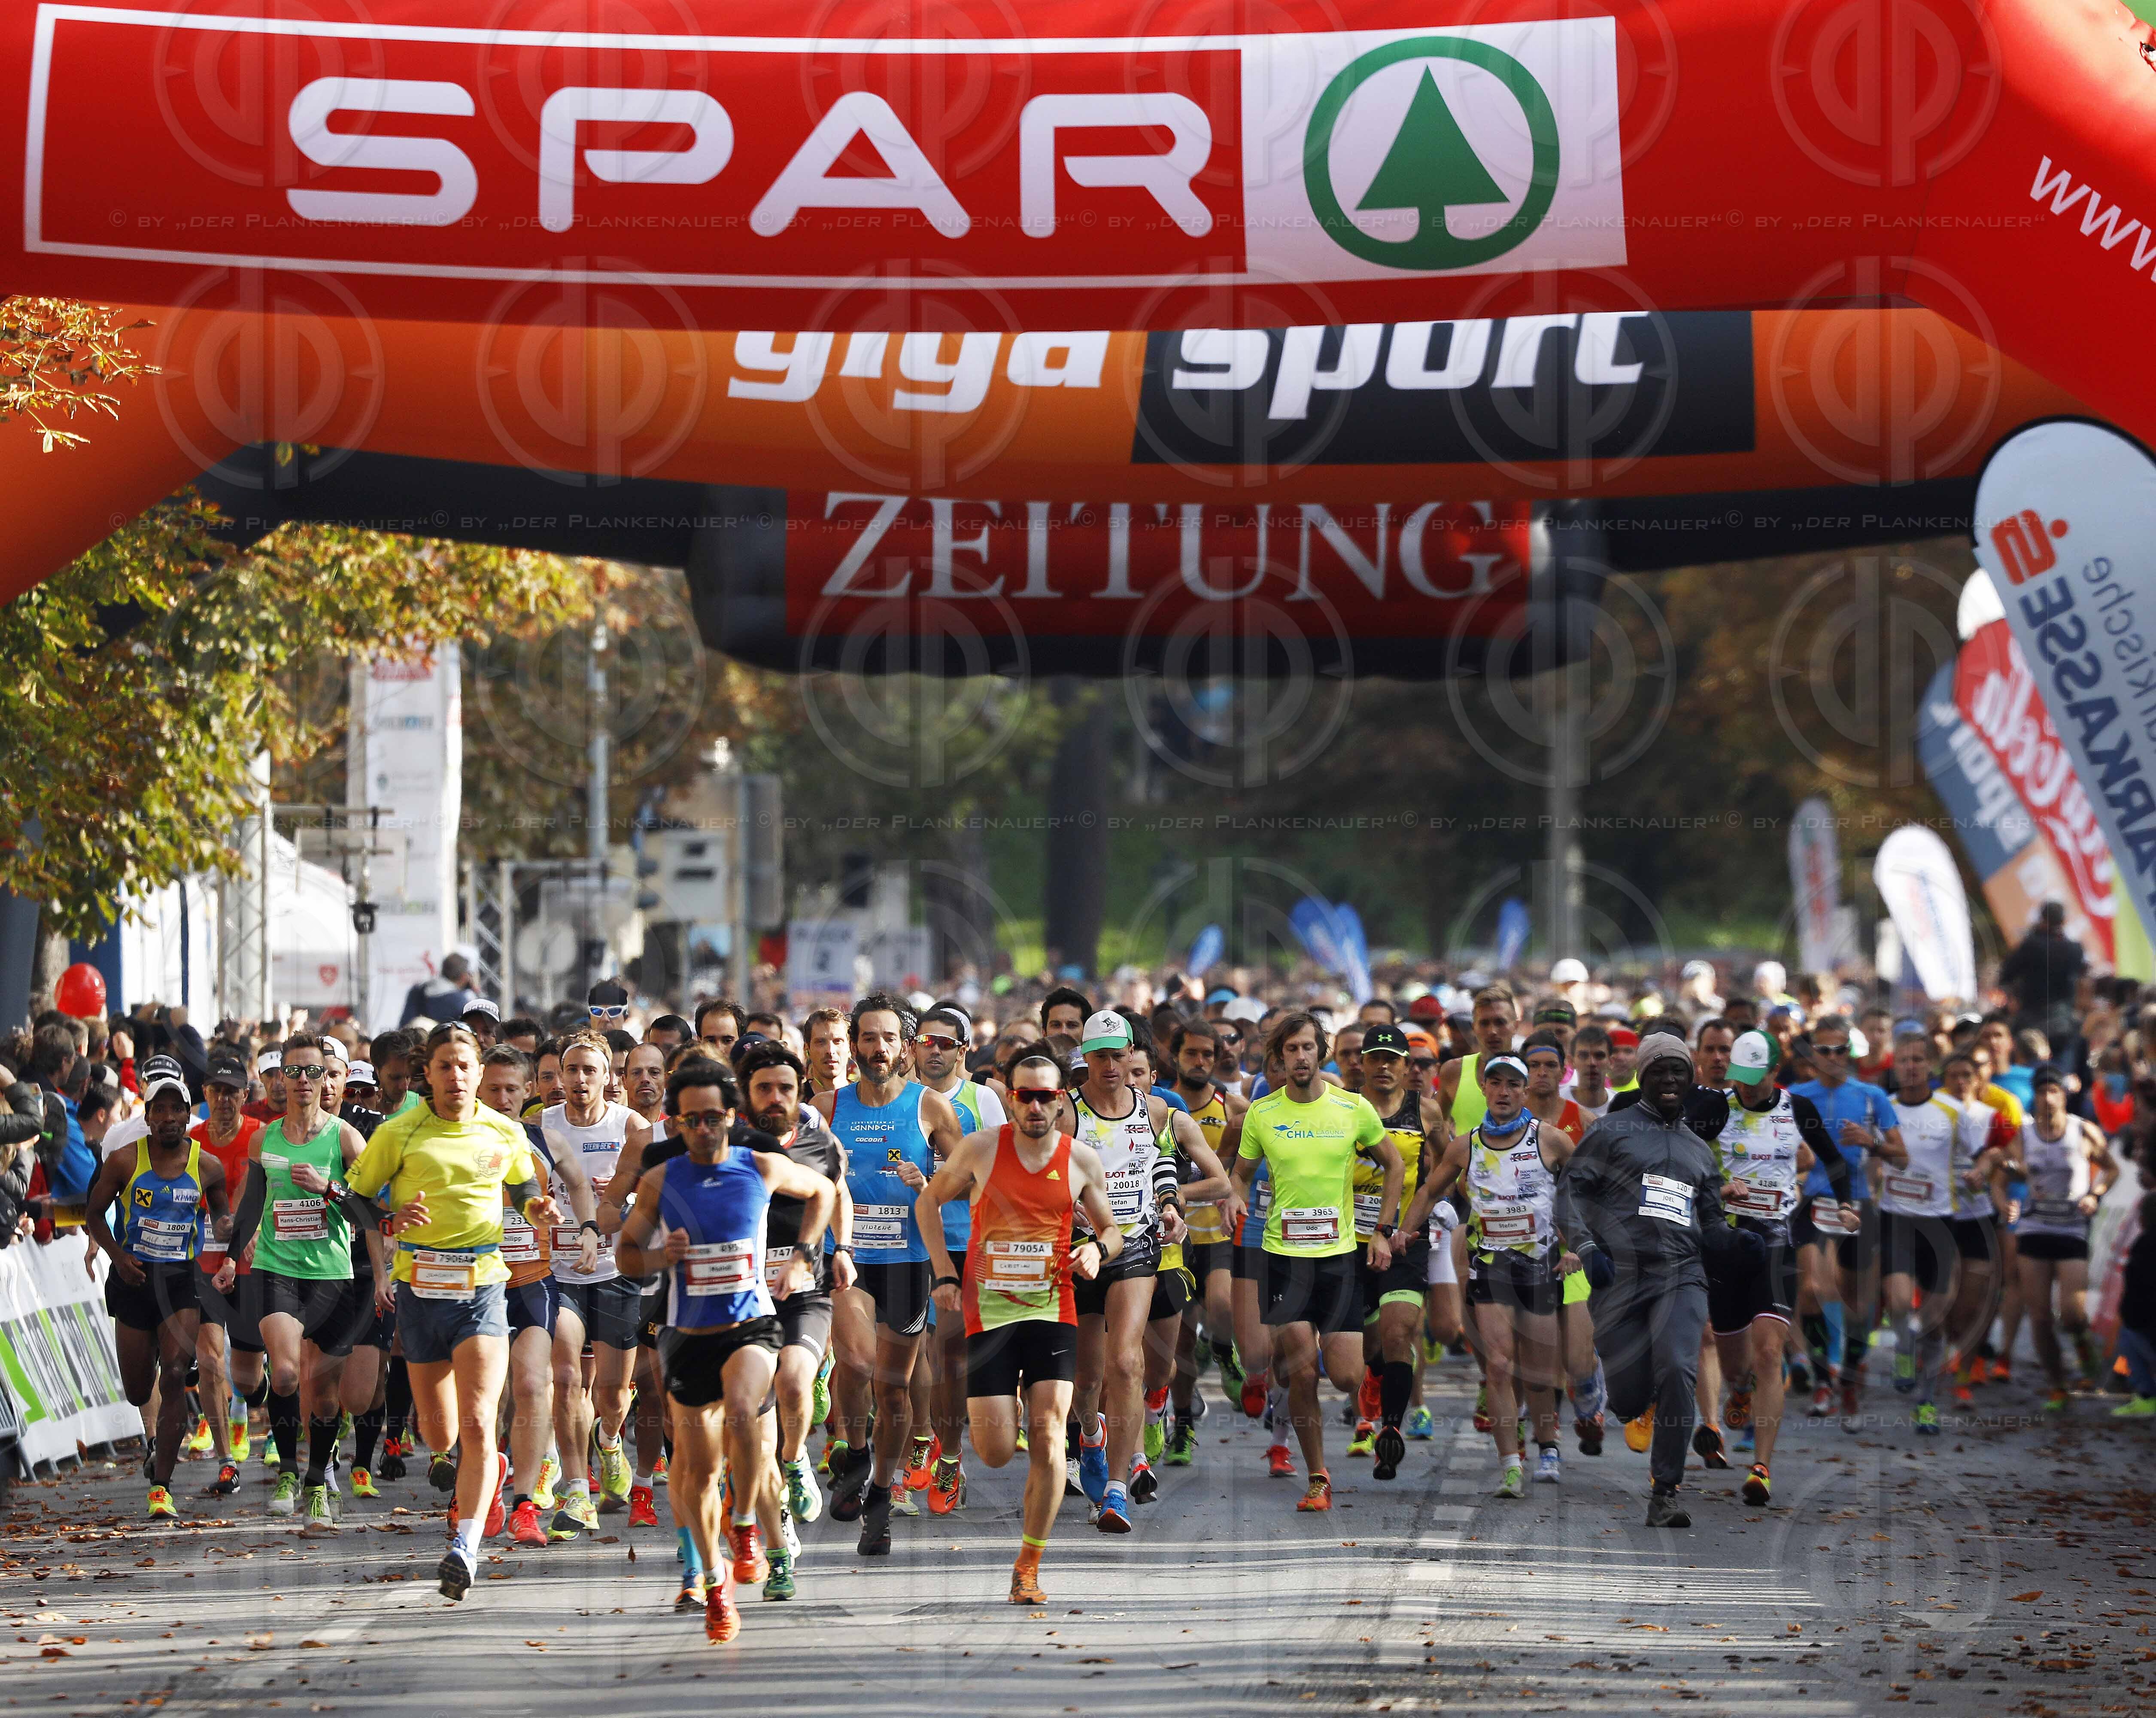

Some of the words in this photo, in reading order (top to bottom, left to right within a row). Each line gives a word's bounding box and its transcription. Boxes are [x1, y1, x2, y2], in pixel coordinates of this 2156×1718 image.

[287, 76, 1213, 238] SPAR
[820, 491, 1503, 601] ZEITUNG
[1286, 1130, 1314, 1138] CHIA
[1113, 1180, 1140, 1189] 20018
[1676, 1182, 1688, 1192] 120
[1758, 1179, 1778, 1188] 4184
[300, 1199, 321, 1207] 4106
[1662, 1194, 1675, 1203] JOEL
[878, 1207, 901, 1215] 1813
[1312, 1208, 1333, 1216] 3965
[1506, 1205, 1527, 1214] 3983
[773, 1247, 794, 1257] 747
[1013, 1244, 1045, 1253] 7905A
